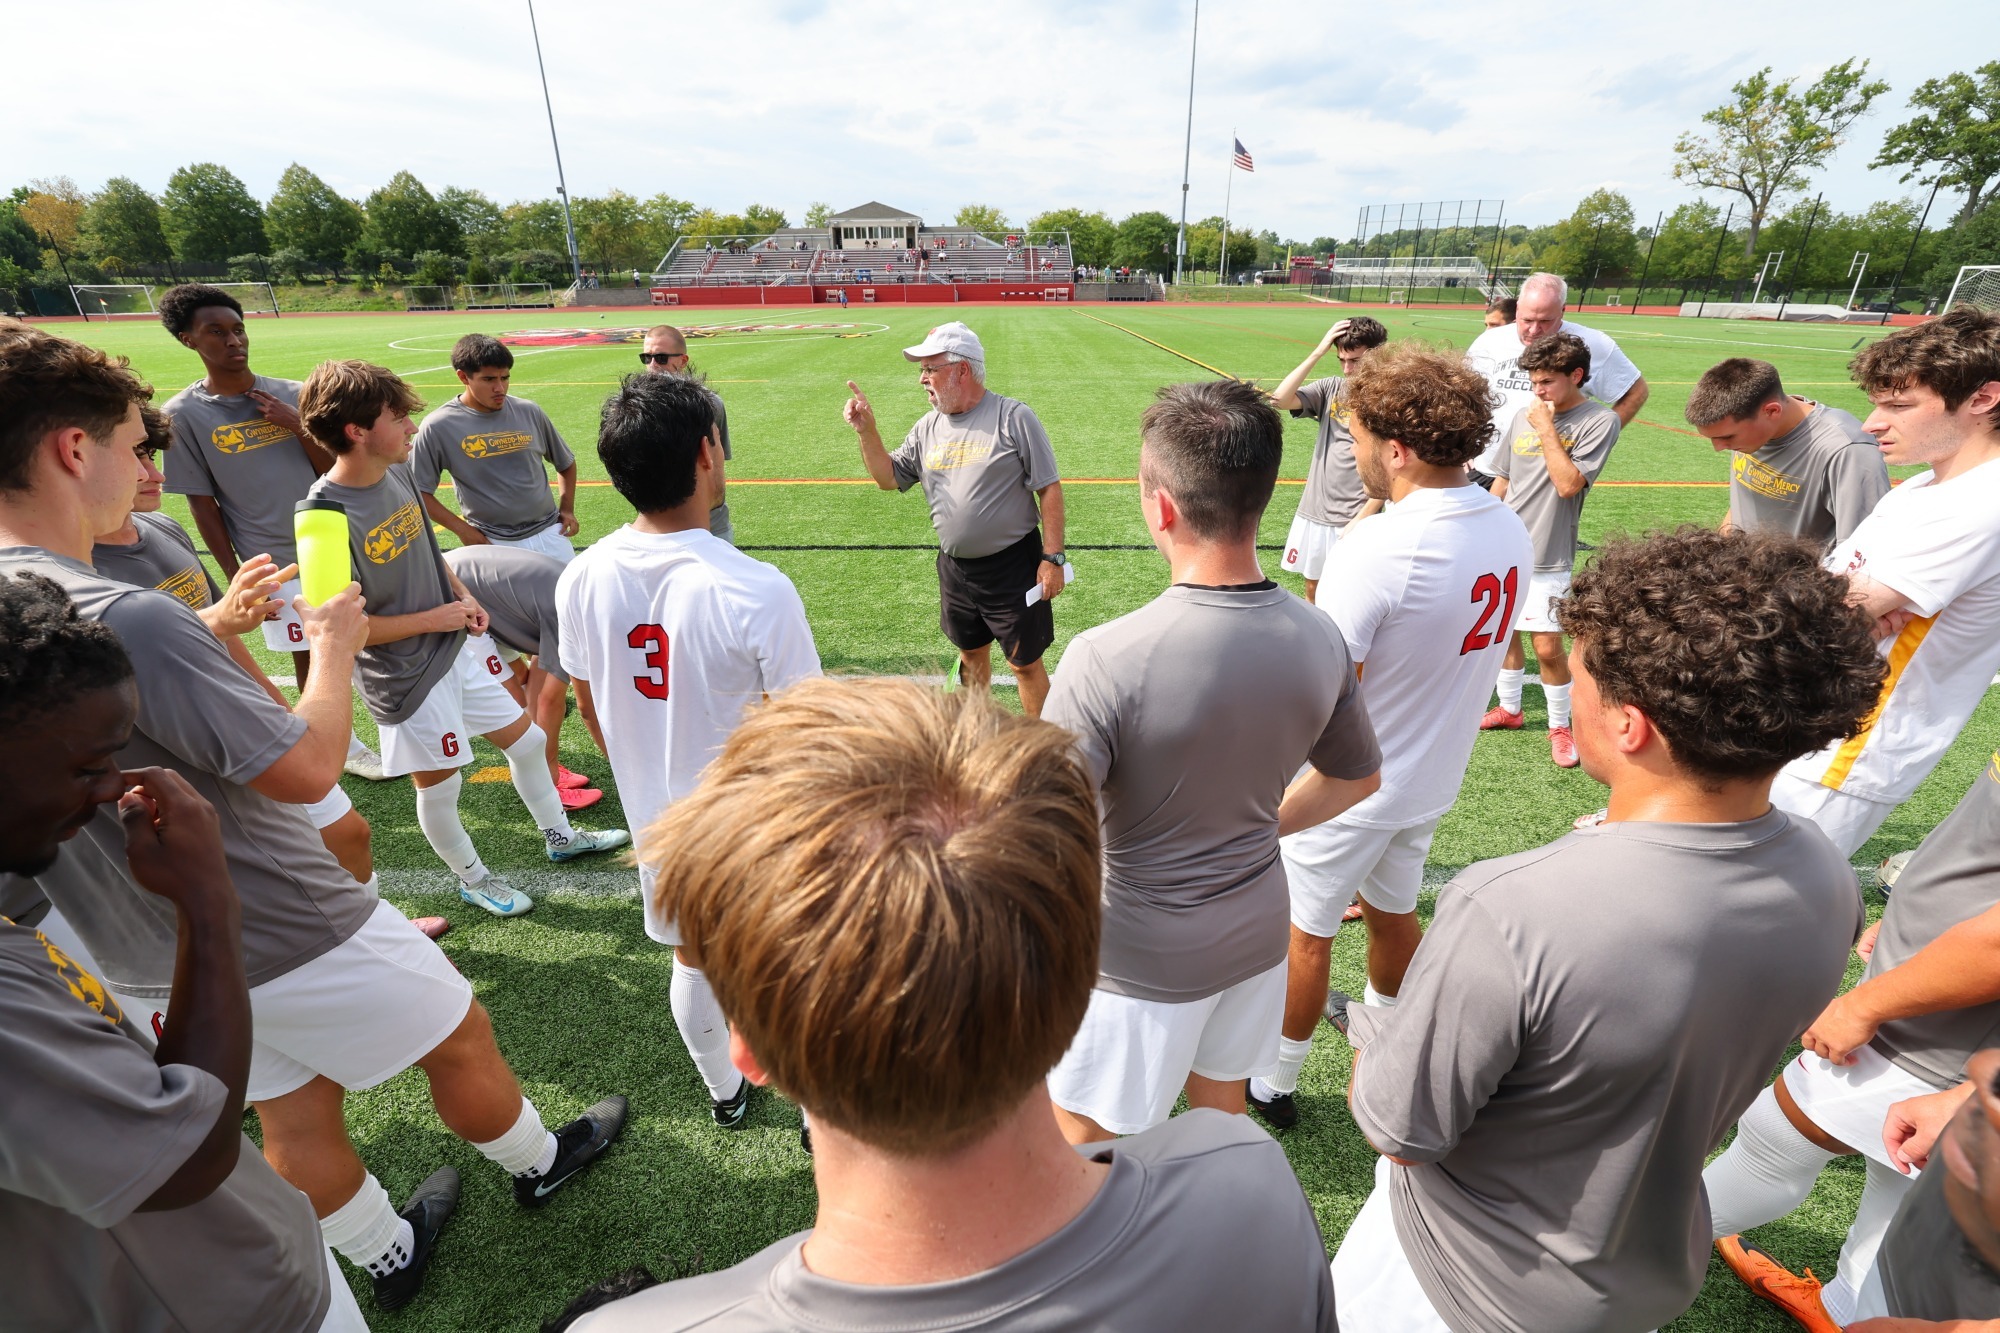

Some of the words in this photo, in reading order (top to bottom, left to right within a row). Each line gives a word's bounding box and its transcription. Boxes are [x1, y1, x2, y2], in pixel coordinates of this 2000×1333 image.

[1287, 548, 1299, 565] G
[1460, 566, 1518, 656] 21
[287, 622, 304, 643] G
[486, 654, 502, 675] G
[627, 623, 670, 702] 3
[441, 732, 459, 758] G
